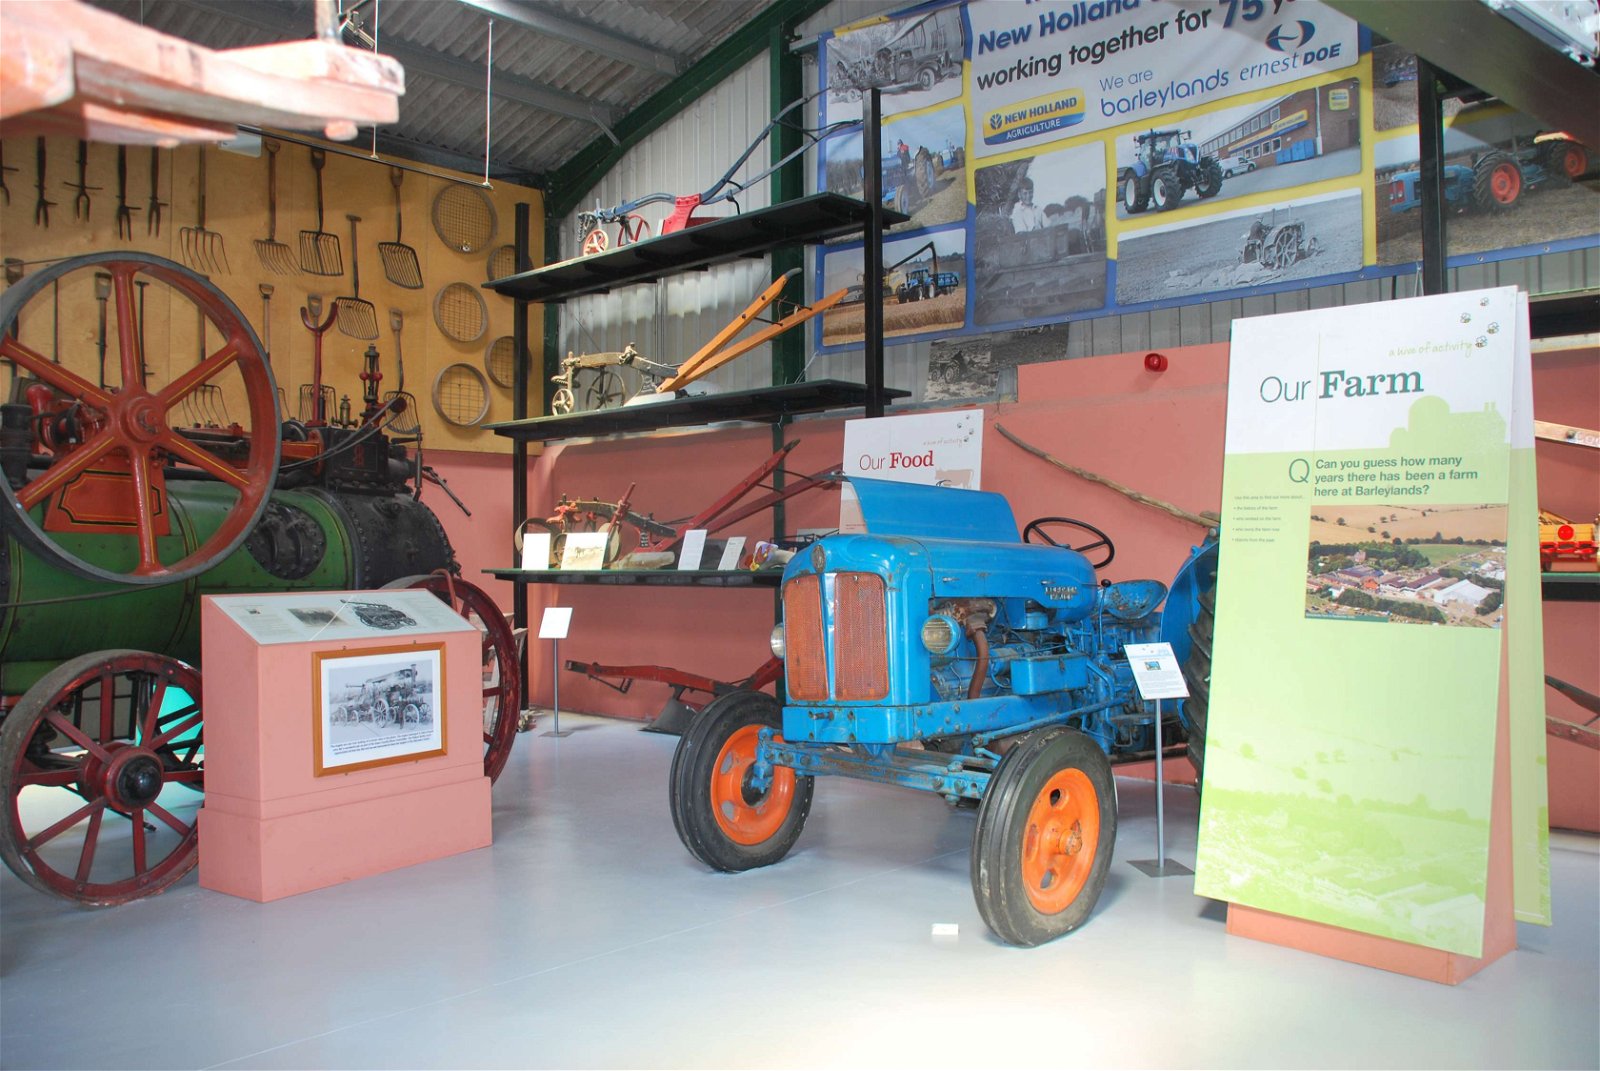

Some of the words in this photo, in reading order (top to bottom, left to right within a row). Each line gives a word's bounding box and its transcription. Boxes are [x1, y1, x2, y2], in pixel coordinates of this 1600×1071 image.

[977, 53, 1062, 91] working
[1069, 21, 1169, 65] together
[1175, 9, 1212, 34] for
[1219, 0, 1264, 29] 75
[978, 24, 1032, 55] New
[1240, 52, 1299, 81] ernest
[1302, 43, 1342, 66] DOE
[1099, 76, 1124, 92] We
[1128, 70, 1153, 86] are
[1101, 68, 1229, 117] barleylands
[1004, 110, 1027, 125] NEW
[1029, 97, 1077, 118] HOLLAND
[1006, 118, 1061, 140] AGRICULTURE
[1260, 376, 1311, 403] Our
[1318, 370, 1424, 399] Farm
[859, 454, 885, 471] Our
[889, 450, 934, 469] Food
[1289, 458, 1310, 484] Q
[1315, 459, 1337, 469] Can
[1340, 460, 1360, 470] you
[1363, 458, 1398, 470] guess
[1400, 456, 1426, 467] how
[1428, 456, 1462, 467] many
[1315, 473, 1344, 485] years
[1347, 472, 1376, 482] there
[1379, 471, 1400, 481] has
[1405, 470, 1435, 480] been
[1438, 472, 1446, 480] a
[1449, 469, 1478, 480] farm
[1314, 486, 1338, 496] here
[1341, 486, 1352, 496] at
[1355, 484, 1430, 498] Barleylands?
